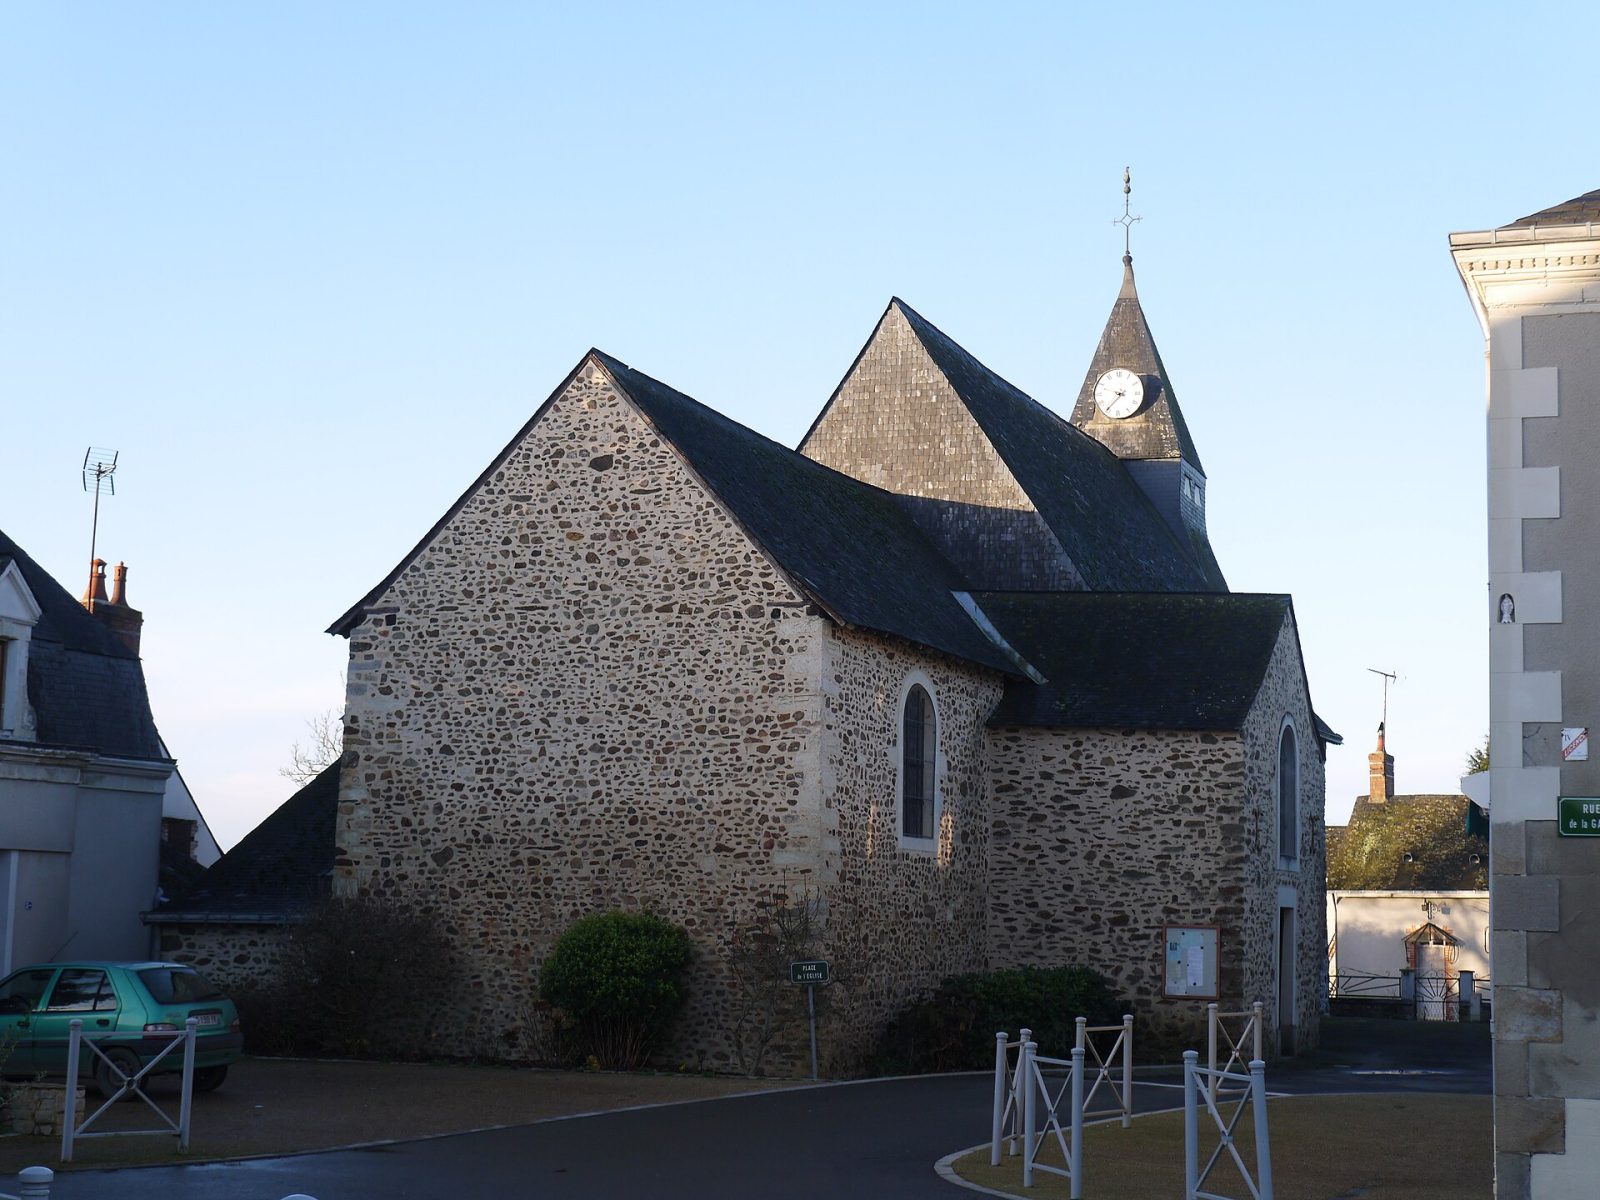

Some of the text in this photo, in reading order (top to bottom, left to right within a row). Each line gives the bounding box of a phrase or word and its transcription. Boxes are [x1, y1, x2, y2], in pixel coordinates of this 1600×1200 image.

[1583, 804, 1600, 813] RUE
[1569, 819, 1577, 828] de
[1582, 819, 1588, 828] la
